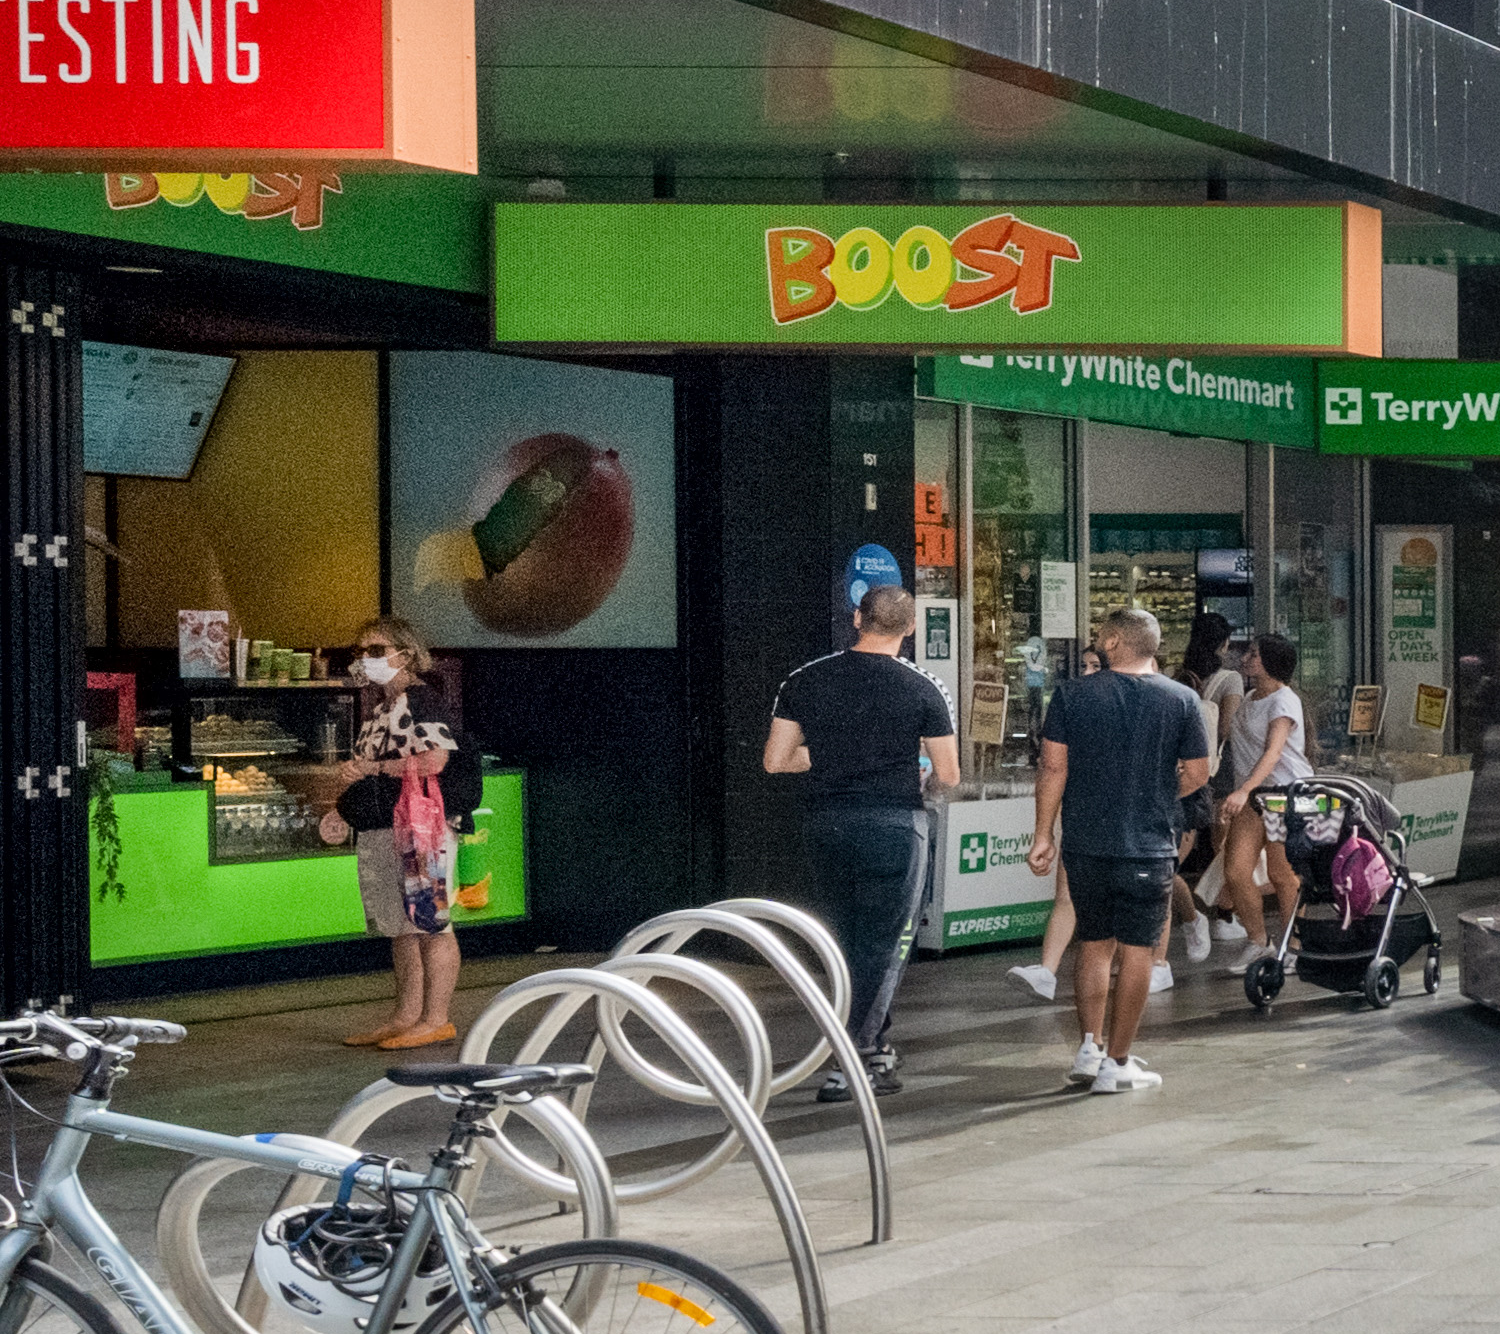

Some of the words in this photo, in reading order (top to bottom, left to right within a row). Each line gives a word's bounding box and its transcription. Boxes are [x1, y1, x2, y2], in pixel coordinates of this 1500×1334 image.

[766, 213, 1082, 325] BOOST
[1166, 358, 1295, 410] Chemmart
[1388, 629, 1425, 640] OPEN
[1388, 641, 1397, 651] 7
[1400, 641, 1433, 651] DAYS
[1388, 652, 1397, 662] A
[1401, 652, 1439, 663] WEEK
[990, 833, 1035, 852] TerryW
[990, 852, 1028, 866] Chem
[949, 915, 1010, 936] EXPRESS
